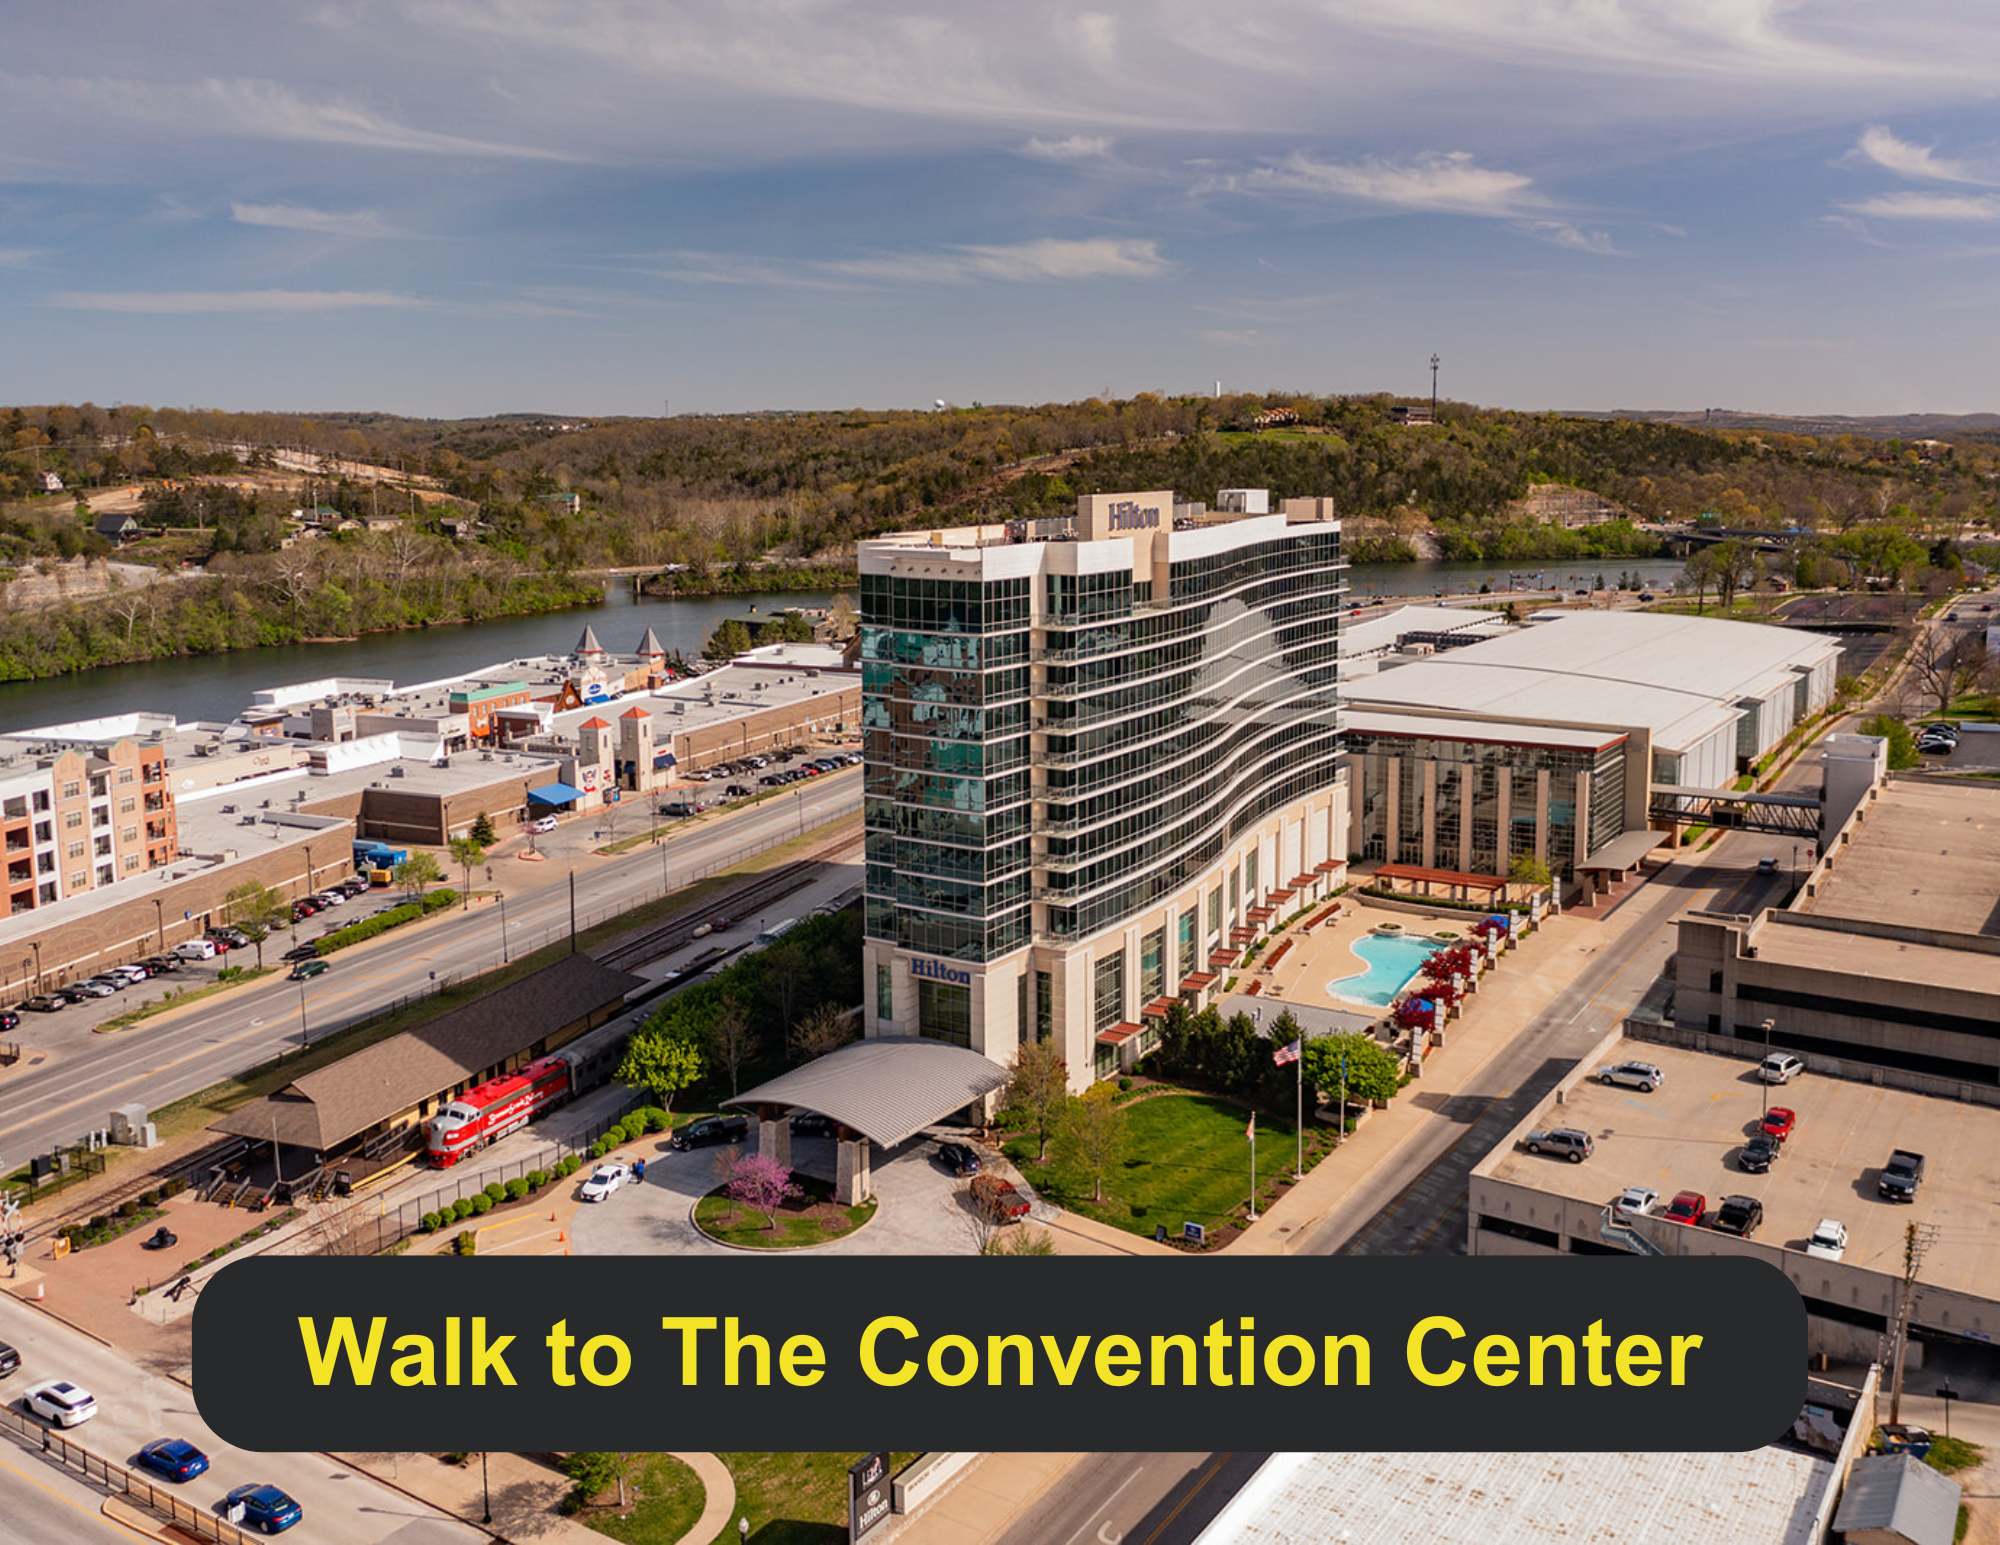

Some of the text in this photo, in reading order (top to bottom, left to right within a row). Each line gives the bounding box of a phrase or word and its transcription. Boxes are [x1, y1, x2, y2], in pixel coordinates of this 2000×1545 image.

[1108, 501, 1160, 531] Hilton
[911, 957, 971, 985] Hilton
[859, 1498, 889, 1529] Hilton
